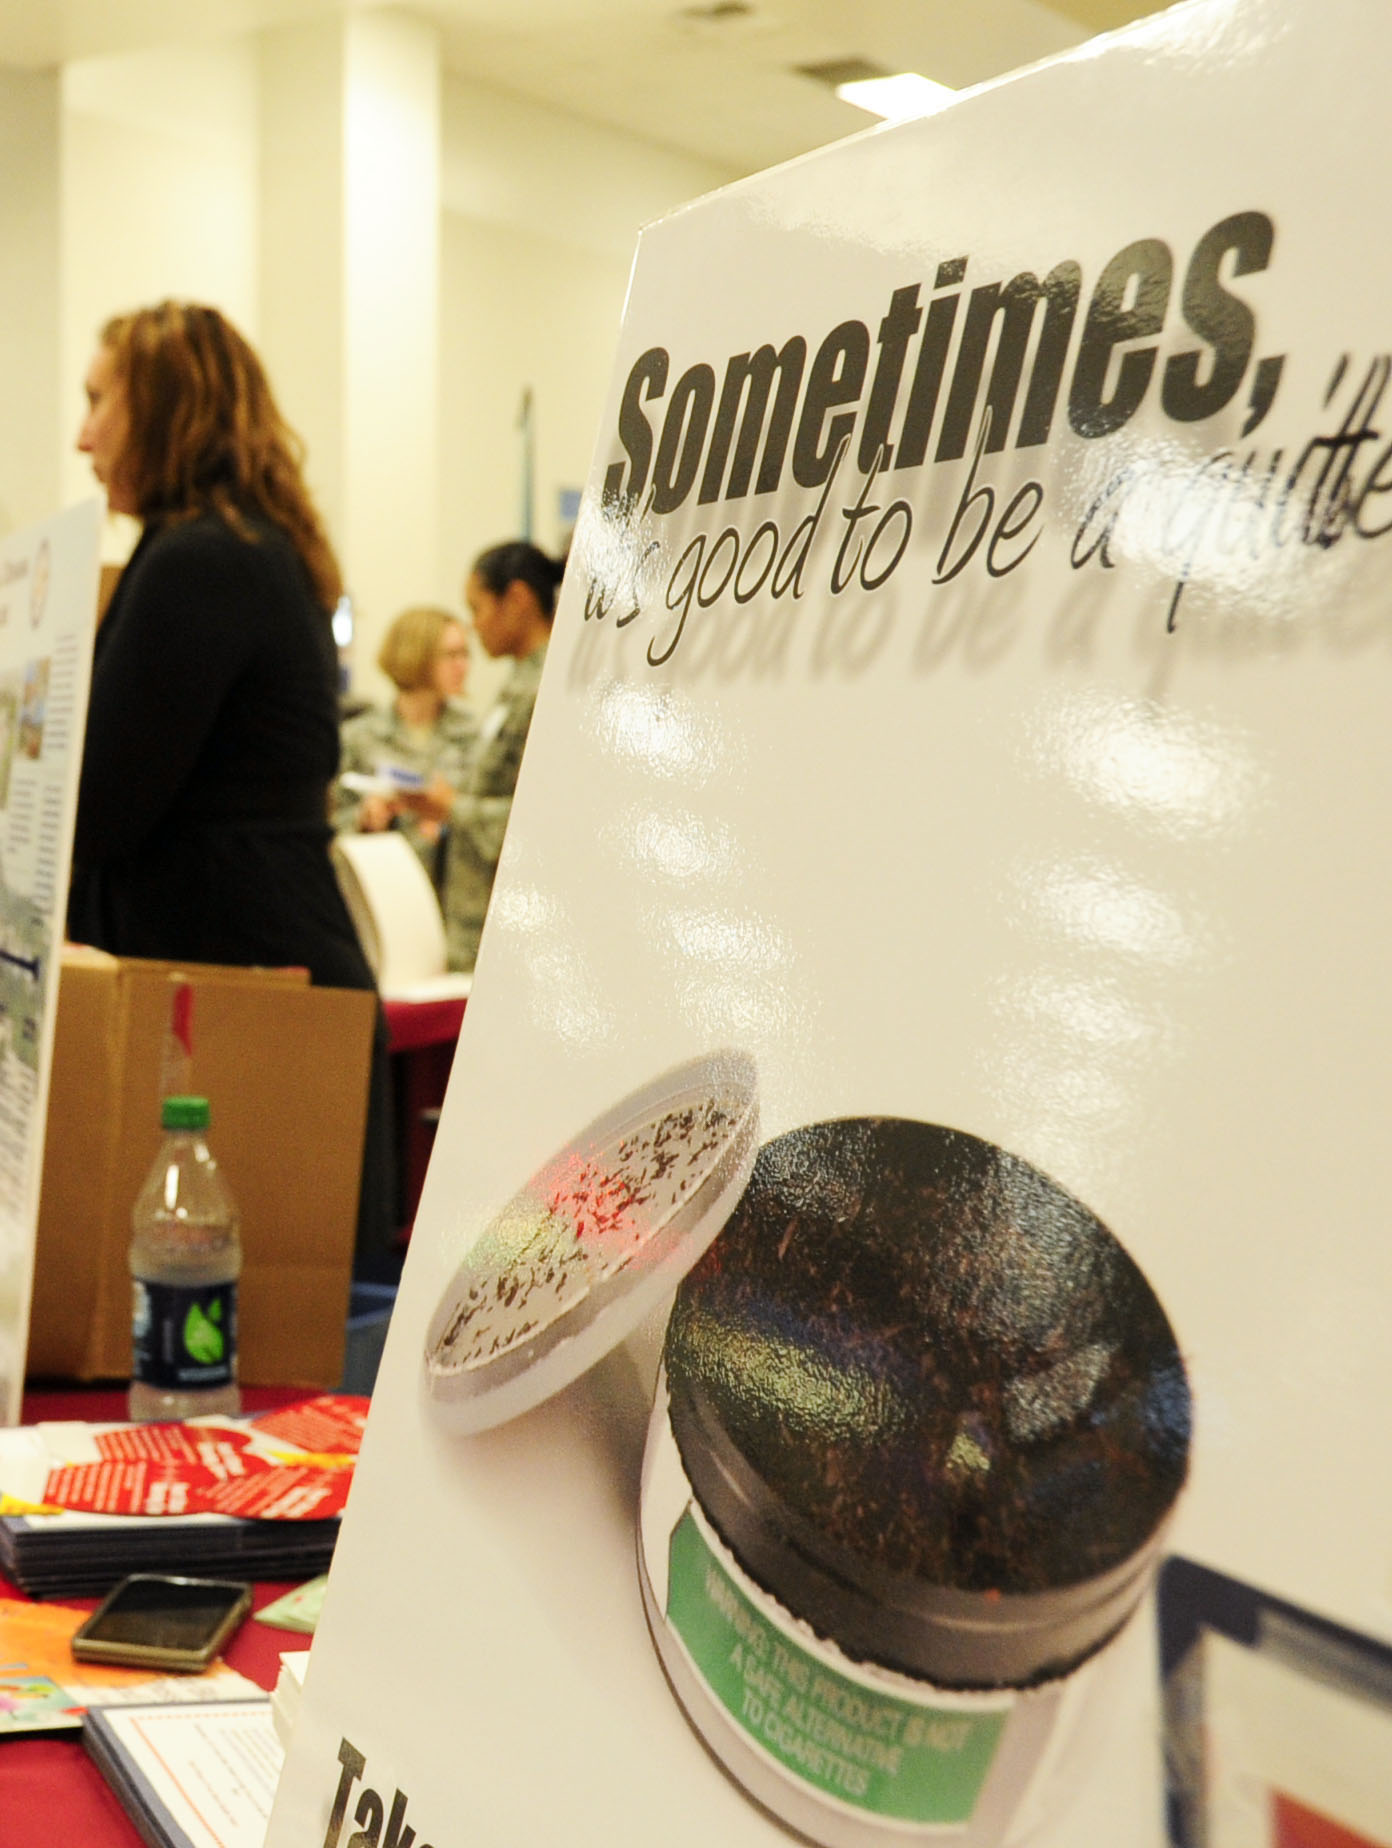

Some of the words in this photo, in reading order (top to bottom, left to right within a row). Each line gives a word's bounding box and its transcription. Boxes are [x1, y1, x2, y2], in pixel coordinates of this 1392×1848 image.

[601, 210, 1286, 521] Sometimes,
[646, 434, 851, 667] good
[830, 445, 912, 594] to
[931, 405, 1044, 586] be
[1070, 463, 1138, 570] a
[322, 1736, 434, 1848] Tak
[742, 1687, 764, 1726] TO
[763, 1711, 872, 1798] CIGARETTES
